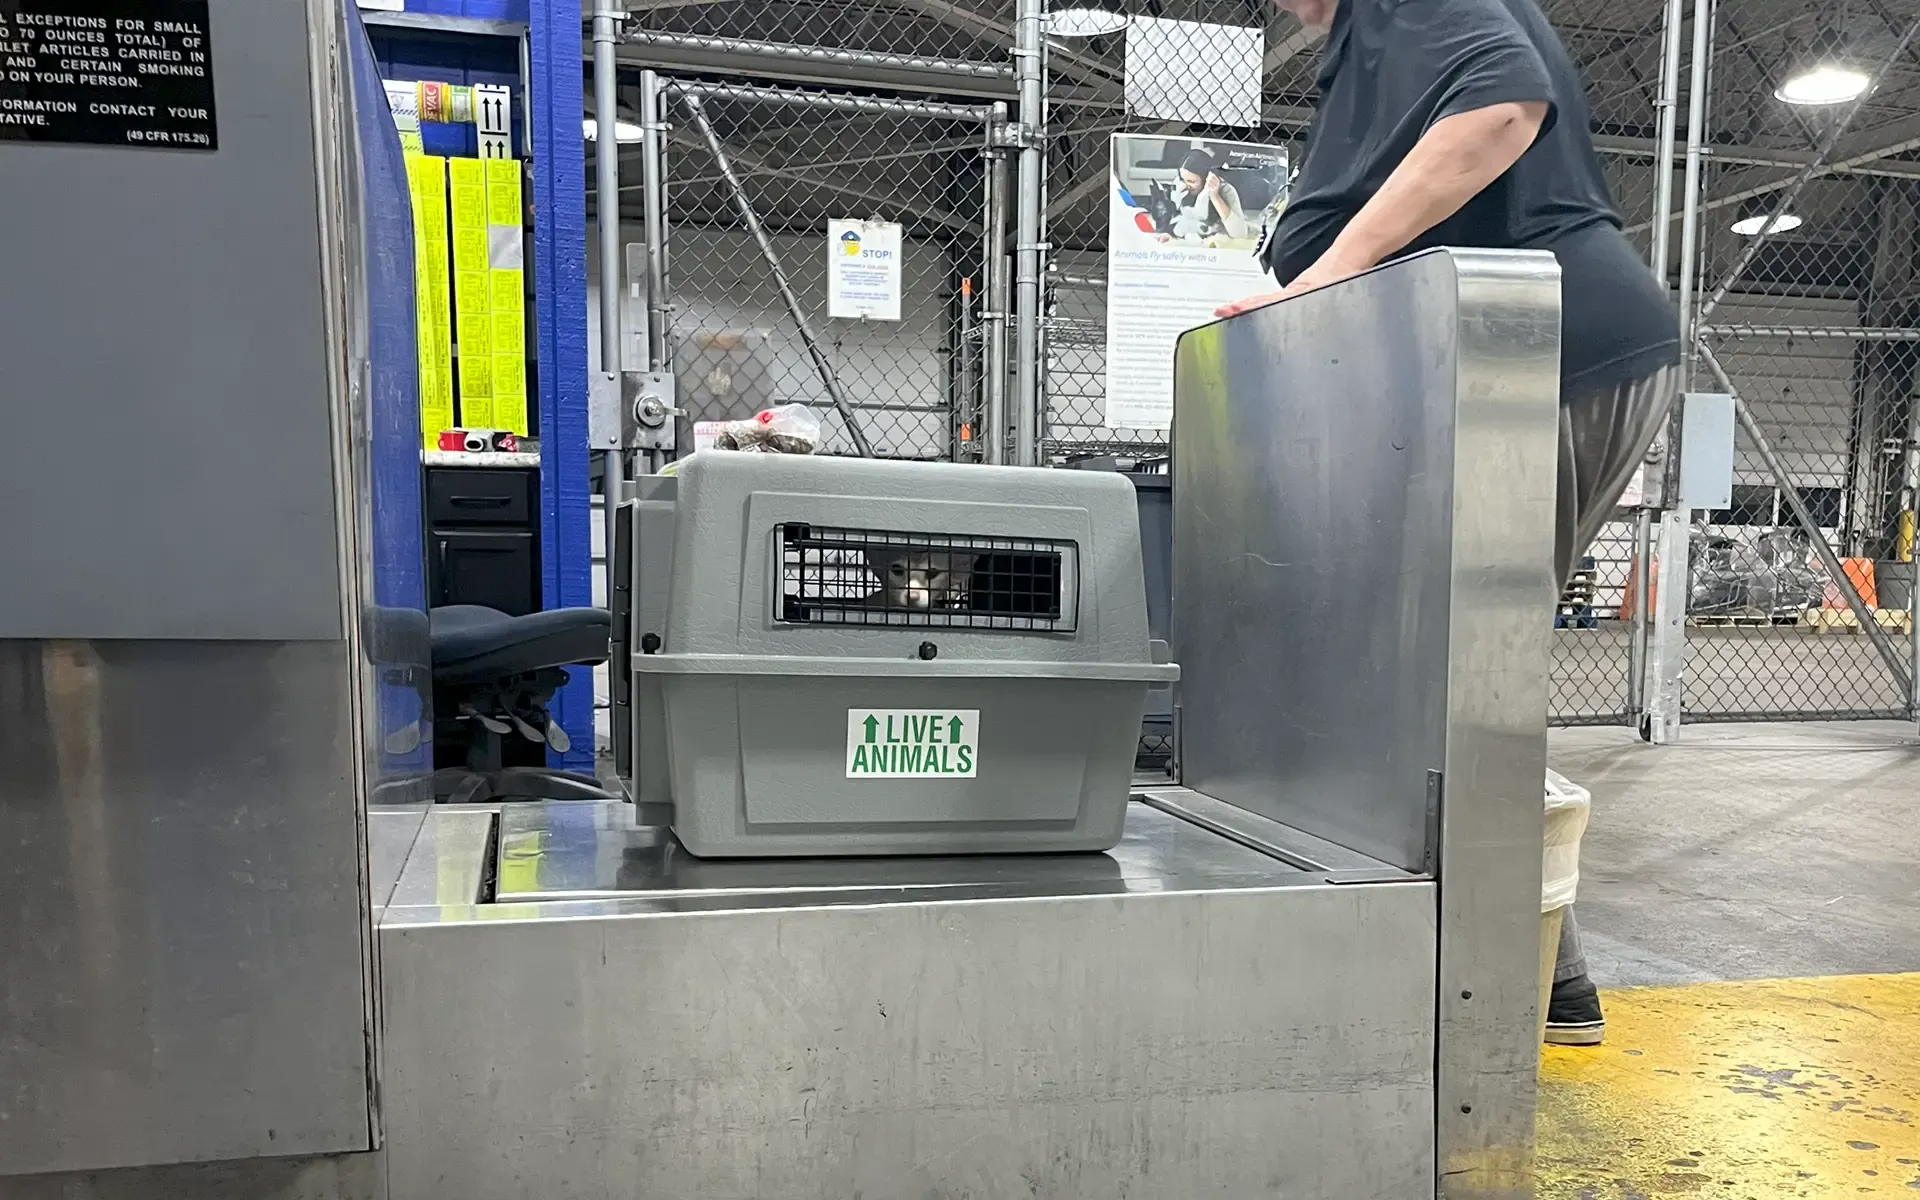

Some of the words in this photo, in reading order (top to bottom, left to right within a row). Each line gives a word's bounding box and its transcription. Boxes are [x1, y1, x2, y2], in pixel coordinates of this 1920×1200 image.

[16, 13, 107, 29] EXCEPTIONS
[116, 19, 145, 31] FOR
[154, 21, 202, 34] SMALL
[19, 28, 36, 40] 70
[45, 29, 105, 43] OUNCES
[115, 33, 167, 48] TOTAL)
[182, 37, 202, 49] OF
[39, 44, 110, 58] ARTICLES
[118, 48, 182, 61] CARRIED
[190, 52, 205, 63] IN
[6, 56, 37, 68] AND
[60, 59, 122, 73] CERTAIN
[138, 63, 205, 78] SMOKING
[9, 71, 30, 82] ON
[34, 72, 75, 85] YOUR
[80, 75, 143, 89] PERSON.
[89, 103, 157, 117] CONTACT
[167, 106, 209, 121] YOUR
[127, 130, 144, 143] (49
[145, 131, 170, 143] CFR
[863, 249, 892, 259] STOP!
[1114, 250, 1149, 260] Animals
[1150, 251, 1161, 262] fly
[1162, 252, 1186, 263] safely
[1188, 253, 1207, 262] with
[1208, 255, 1218, 263] us
[886, 715, 944, 743] LIVE
[852, 744, 973, 774] ANIMALS
